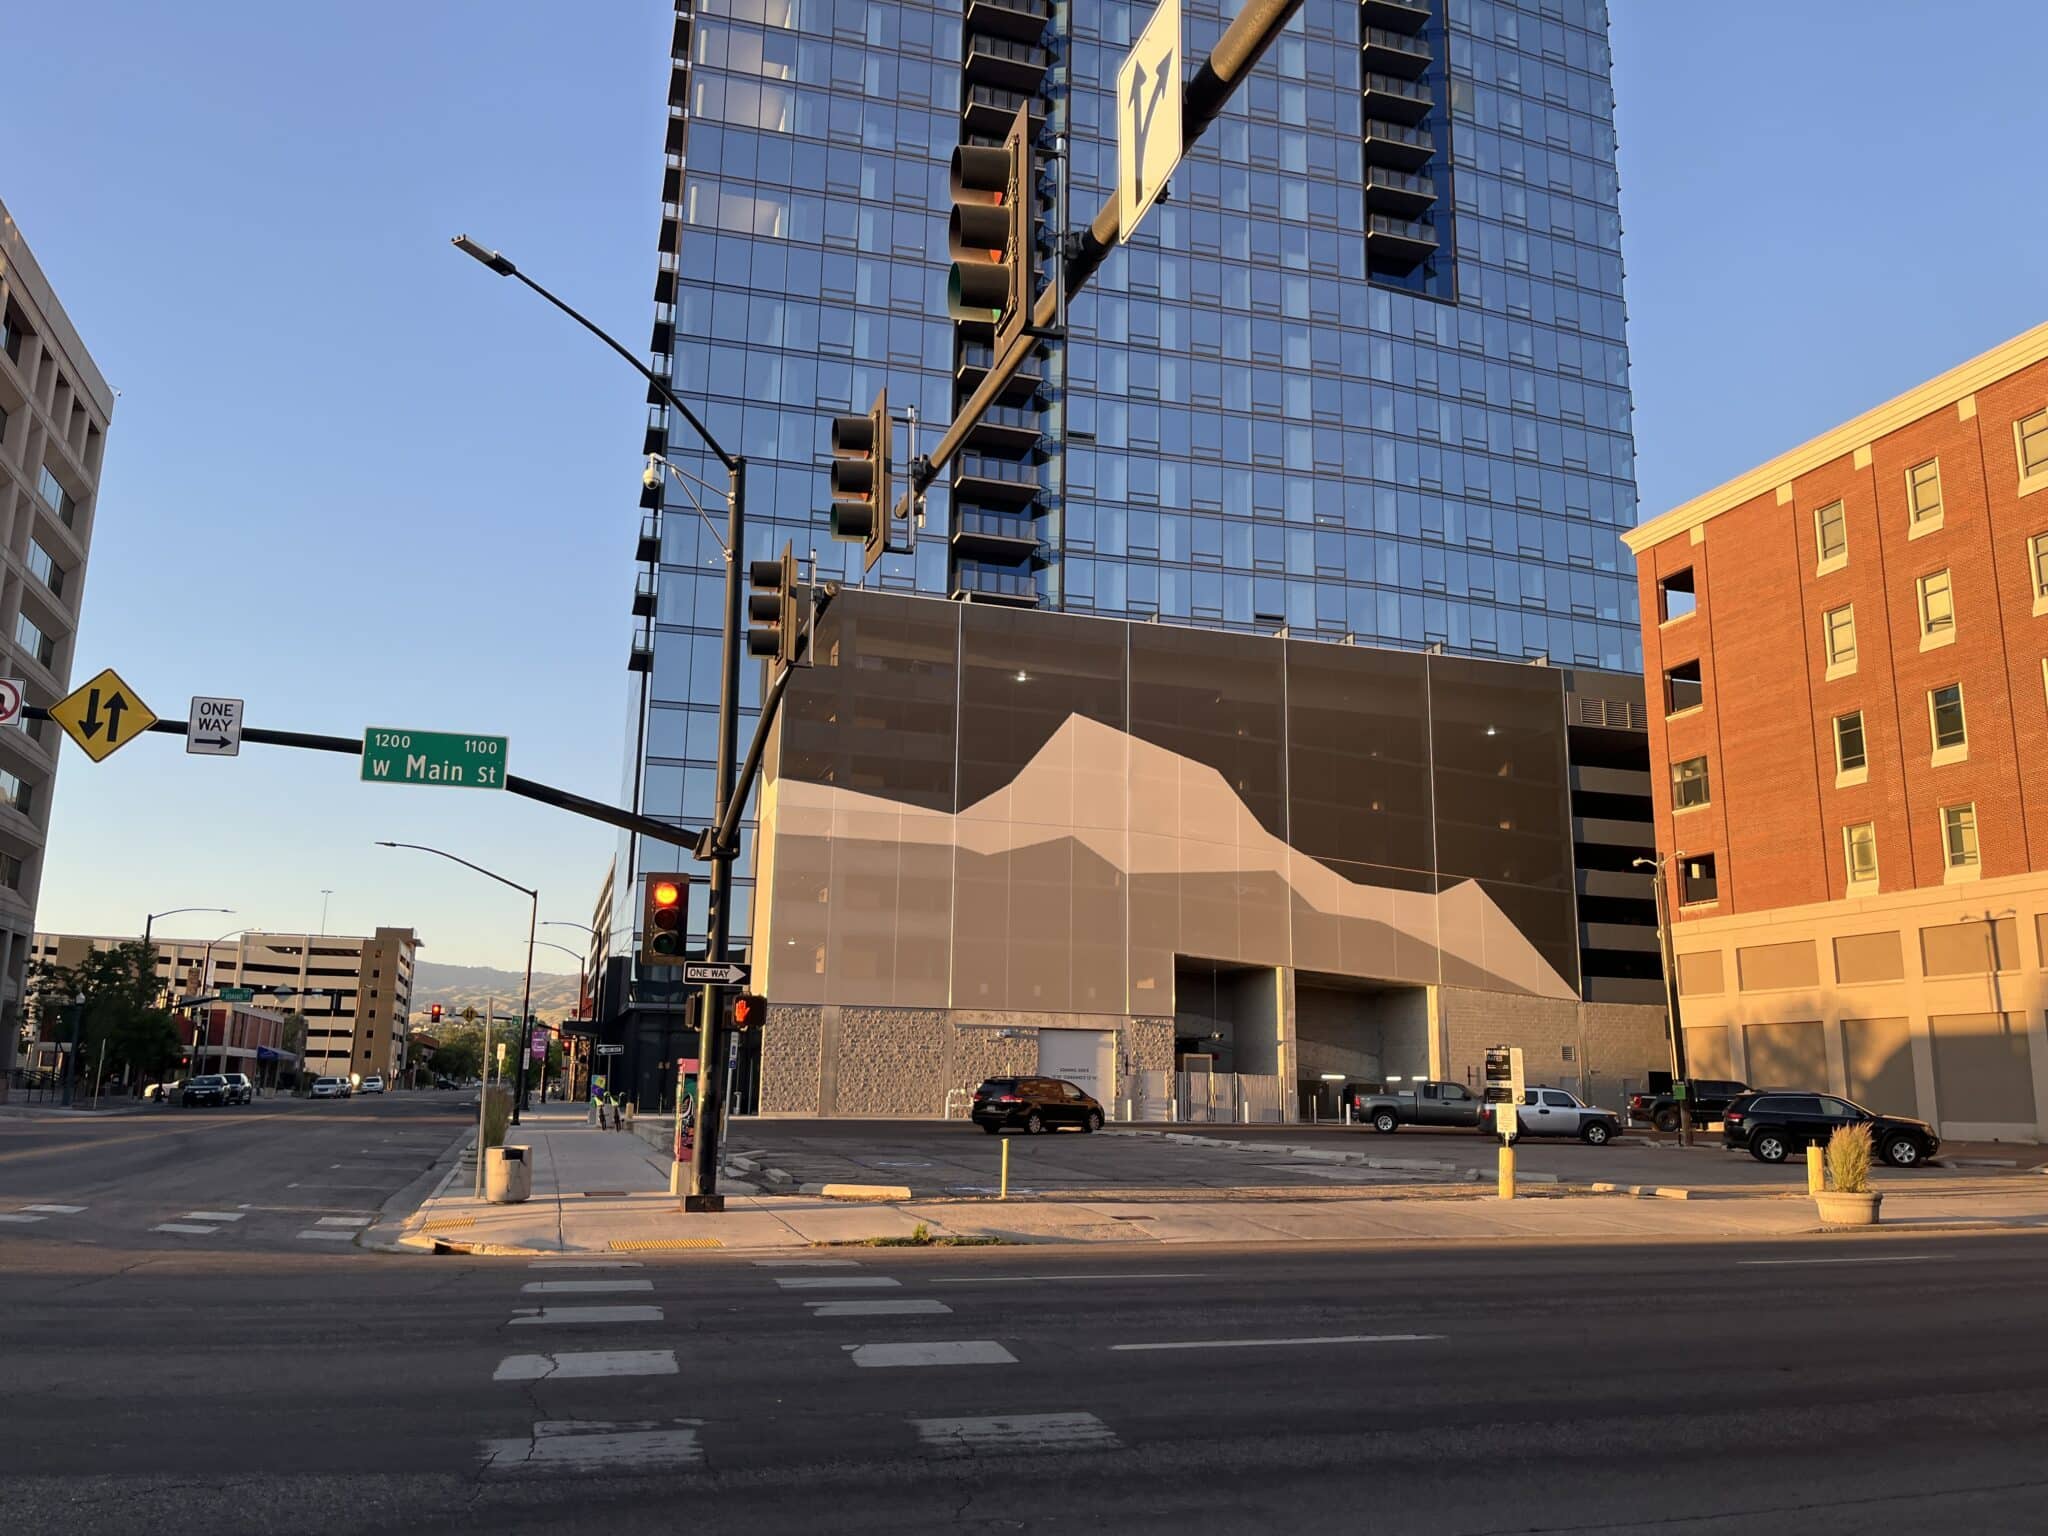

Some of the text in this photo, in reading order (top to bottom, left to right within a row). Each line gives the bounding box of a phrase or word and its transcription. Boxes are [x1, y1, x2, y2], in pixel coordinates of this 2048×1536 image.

[200, 702, 233, 717] ONE
[199, 717, 232, 732] WAY
[375, 734, 498, 754] 1200 1100
[373, 754, 496, 783] W Main St
[690, 969, 729, 978] ONE WAY
